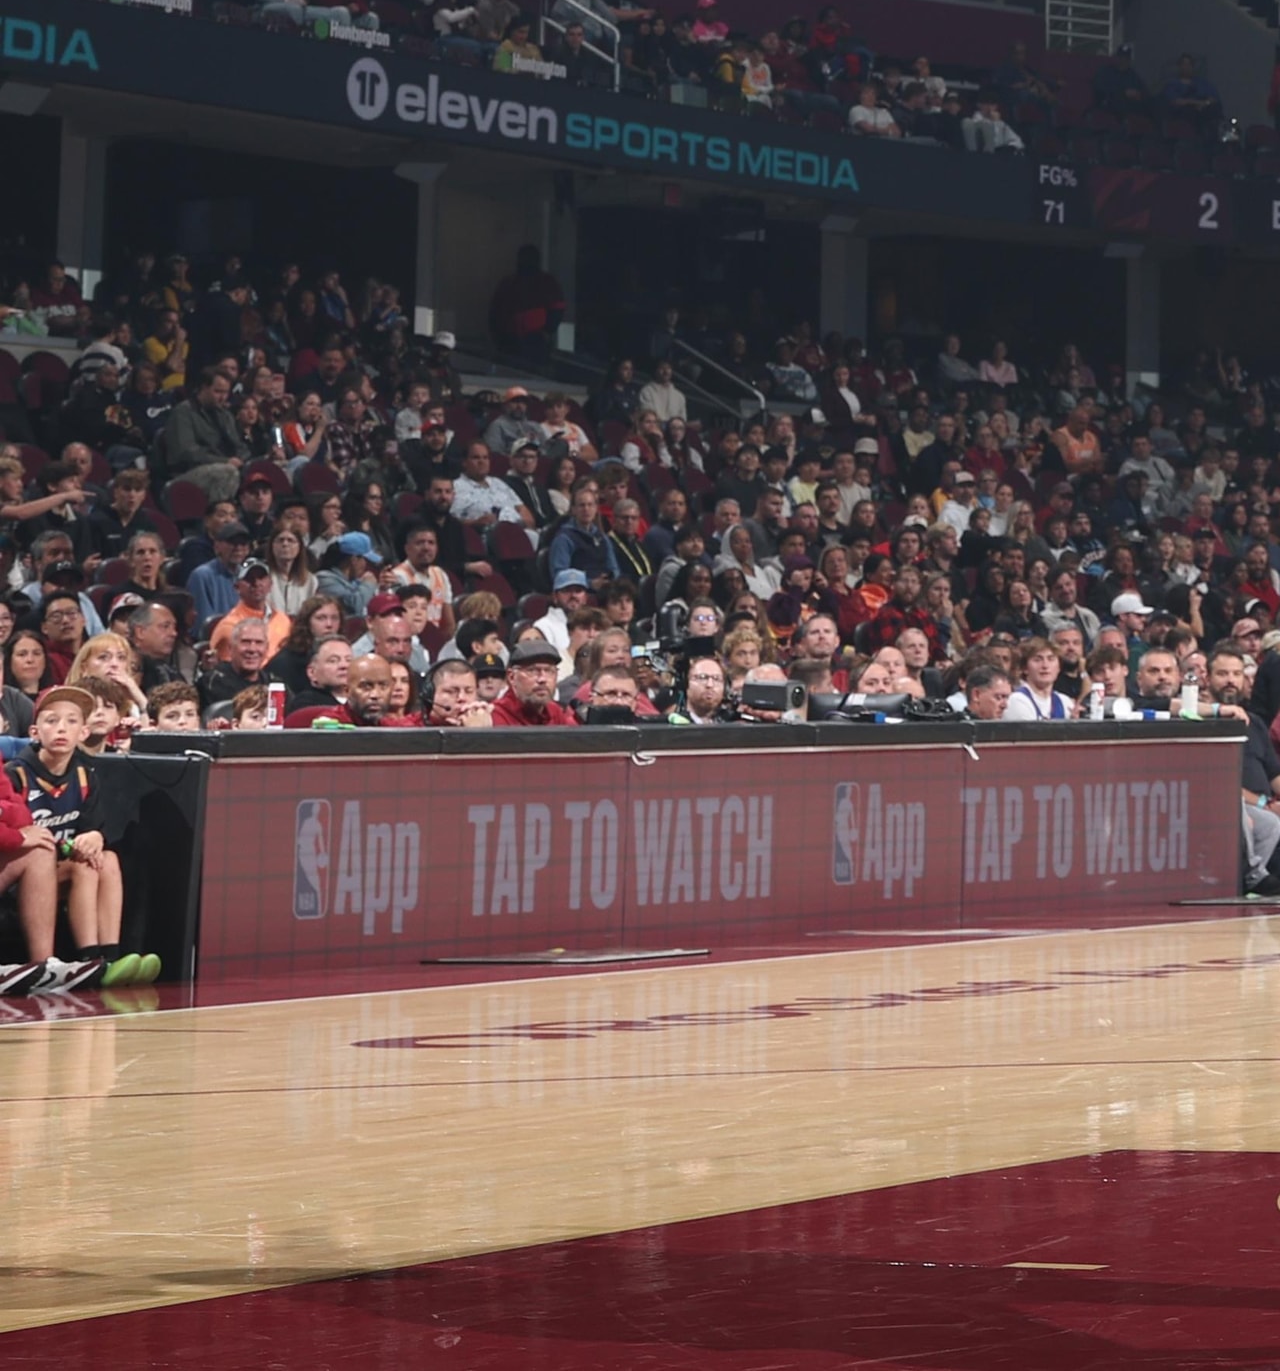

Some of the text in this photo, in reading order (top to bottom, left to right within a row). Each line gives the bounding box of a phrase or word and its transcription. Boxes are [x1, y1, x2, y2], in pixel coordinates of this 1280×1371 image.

[0, 17, 99, 71] DIA
[330, 20, 390, 48] Huntington
[512, 52, 567, 80] Huntington
[396, 74, 859, 191] eleven SPORTS MEDIA
[1039, 165, 1077, 187] FG%
[1043, 200, 1065, 224] 71
[1198, 192, 1219, 229] 2
[334, 780, 1189, 936] App TAP TO WATCH App TAP TO WATCH
